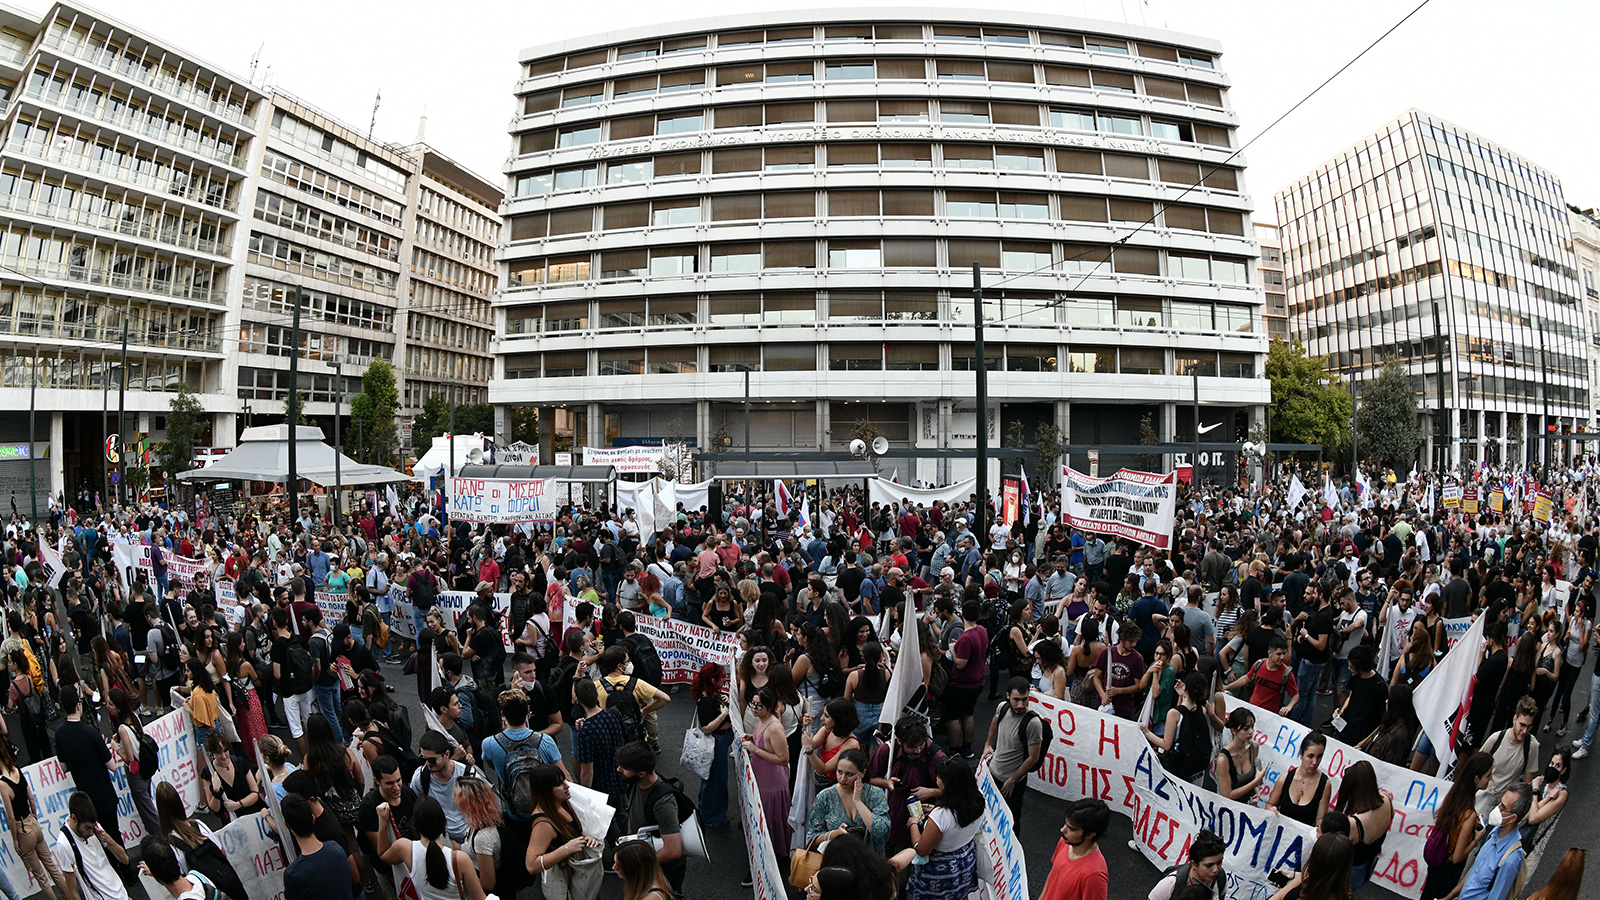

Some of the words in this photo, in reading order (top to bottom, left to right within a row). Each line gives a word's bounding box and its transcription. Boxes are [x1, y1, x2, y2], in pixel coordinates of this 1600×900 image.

[587, 143, 651, 158] ΥΠΟΥΡΓΕΙΟ
[660, 135, 745, 150] ΟΙΚΟΝΟΜΙΚΩΝ
[767, 131, 841, 142] ΥΠΟΥΡΓΕΙΟ
[851, 130, 934, 138] ΟΙΚΟΝΟΜΙΑΣ
[943, 131, 1085, 146] ΑΝΤΑΓΩΝΙΣΤΙΚΟΤΗΤΑΣ
[1108, 141, 1170, 155] ΝΑΥΤΙΛΙΑΣ
[1212, 452, 1225, 466] IT.
[453, 478, 485, 498] ΠΑΝΩ
[508, 479, 545, 499] ΜΙΣΘΟΙ
[453, 494, 482, 513] ΚΑΤΩ
[508, 496, 540, 513] ΦΟΡΟΙ
[450, 511, 474, 519] ΕΡΓΑΤΙΚΟ
[476, 514, 498, 522] ΚΕΝΤΡΟ
[328, 603, 346, 611] ΠΟΛΕ
[435, 593, 463, 609] ΑΜΗΛΟΙ
[674, 623, 689, 633] ΤΟΥ
[690, 626, 711, 639] ΝΑΤΟ
[711, 632, 721, 641] ΤΑ
[696, 639, 730, 654] ΠΟΛΕΜ
[691, 662, 698, 671] &
[1098, 718, 1120, 760] Η
[1077, 762, 1114, 802] ΤΙΣ
